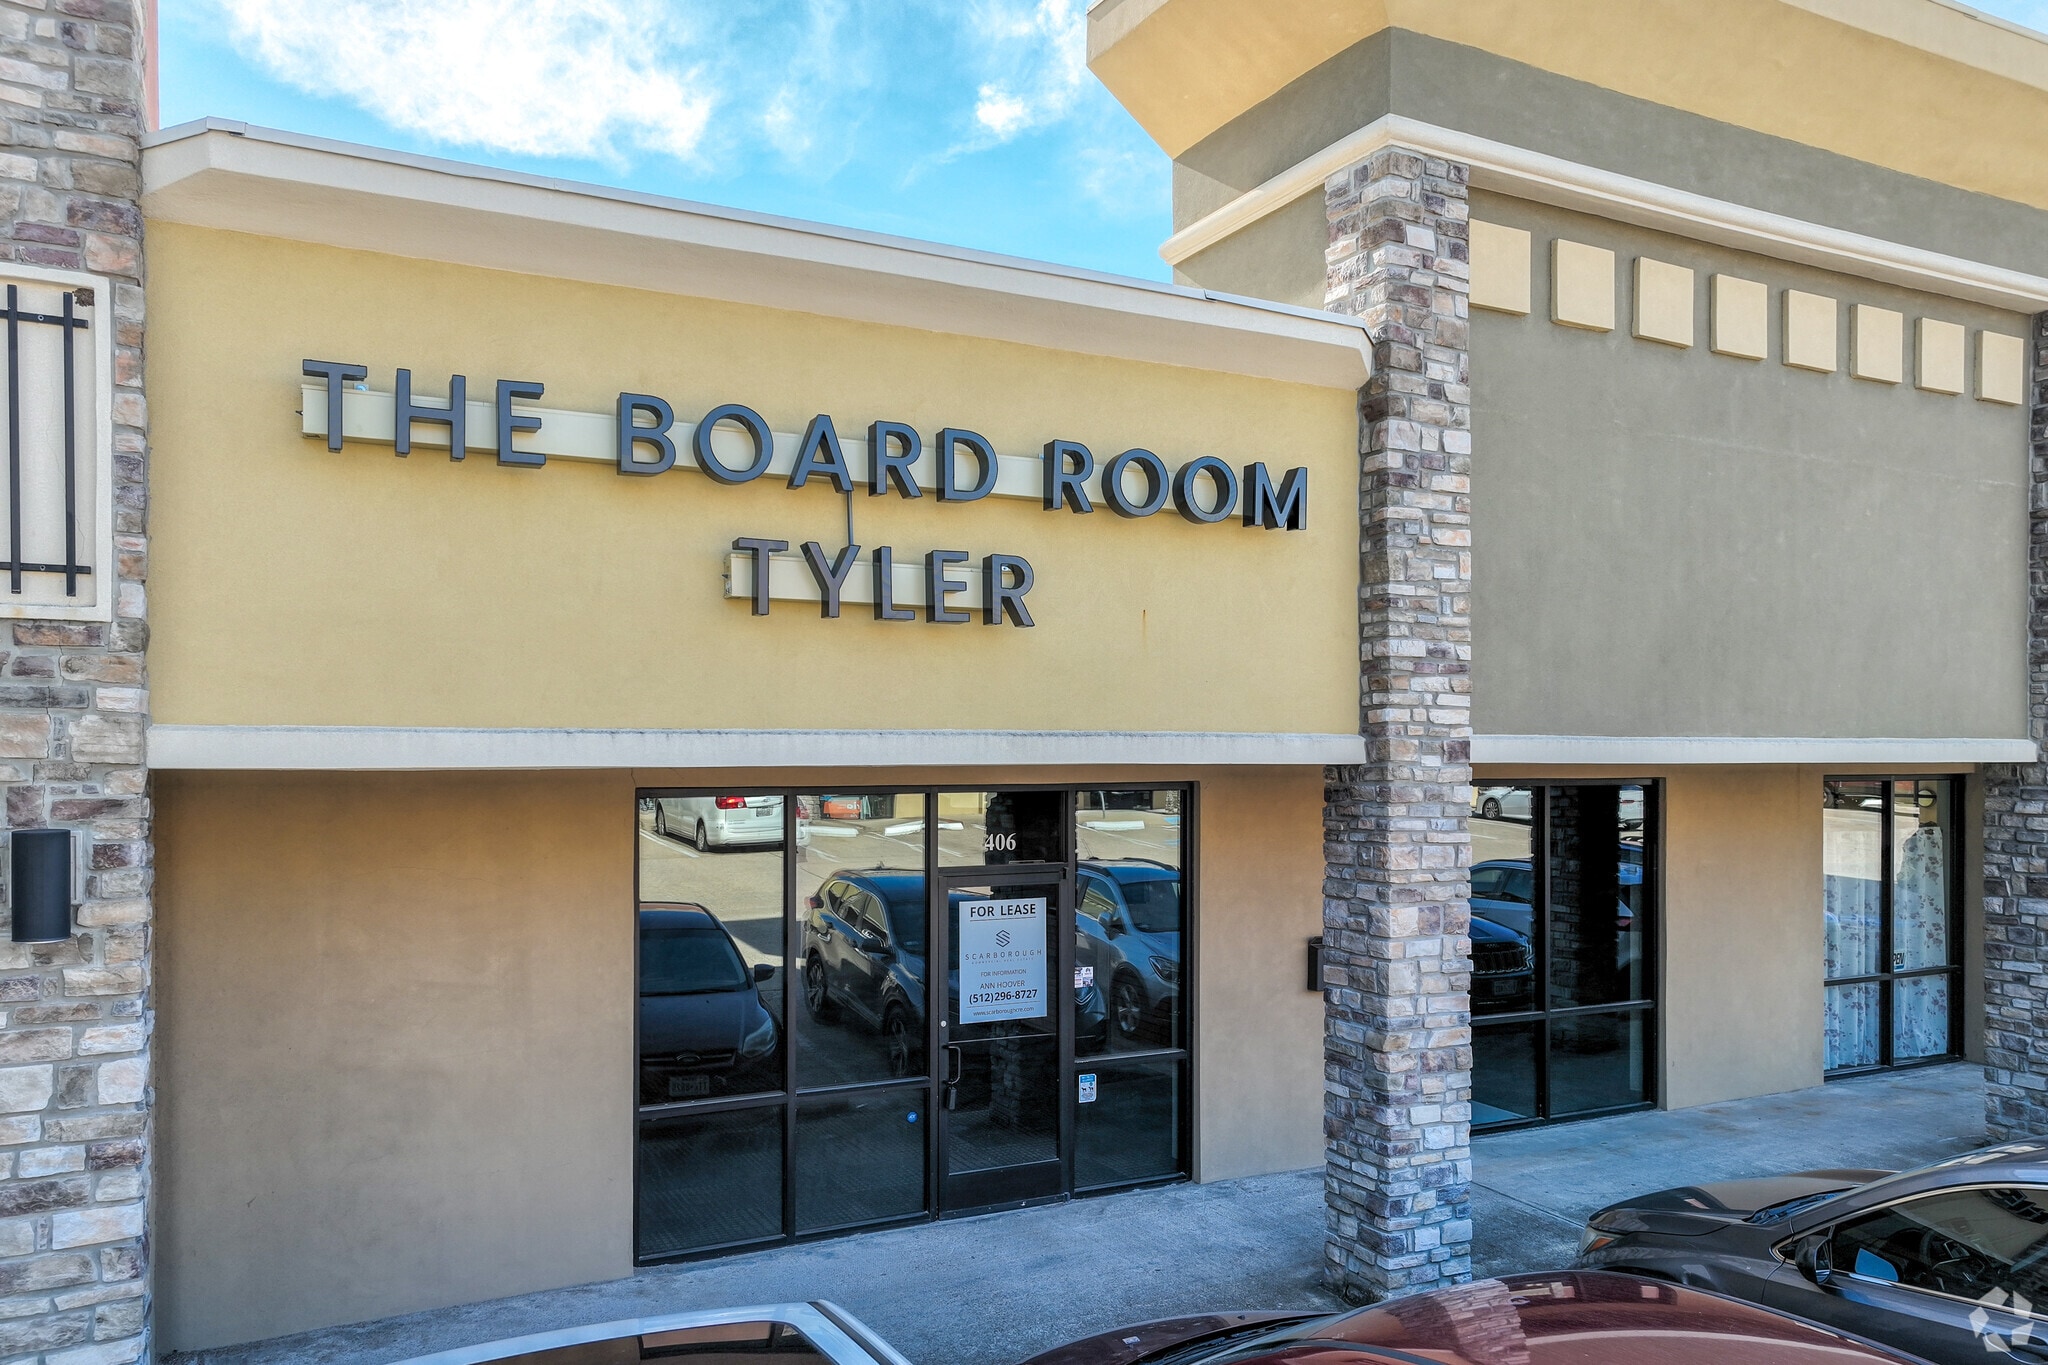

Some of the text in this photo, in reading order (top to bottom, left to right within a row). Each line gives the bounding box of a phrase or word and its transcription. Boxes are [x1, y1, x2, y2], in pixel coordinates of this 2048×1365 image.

[302, 359, 1309, 532] THE BOARD ROOM
[731, 537, 1036, 628] TYLER
[984, 833, 1017, 851] 406
[970, 903, 1036, 918] FOR LEASE
[965, 949, 1042, 960] SCARBOROUGH
[1892, 952, 1905, 965] PEN
[980, 980, 1026, 990] ANN HOOVER
[969, 989, 1038, 1005] (512)296-8727
[973, 1006, 1035, 1016] www.scarboroughcre.com
